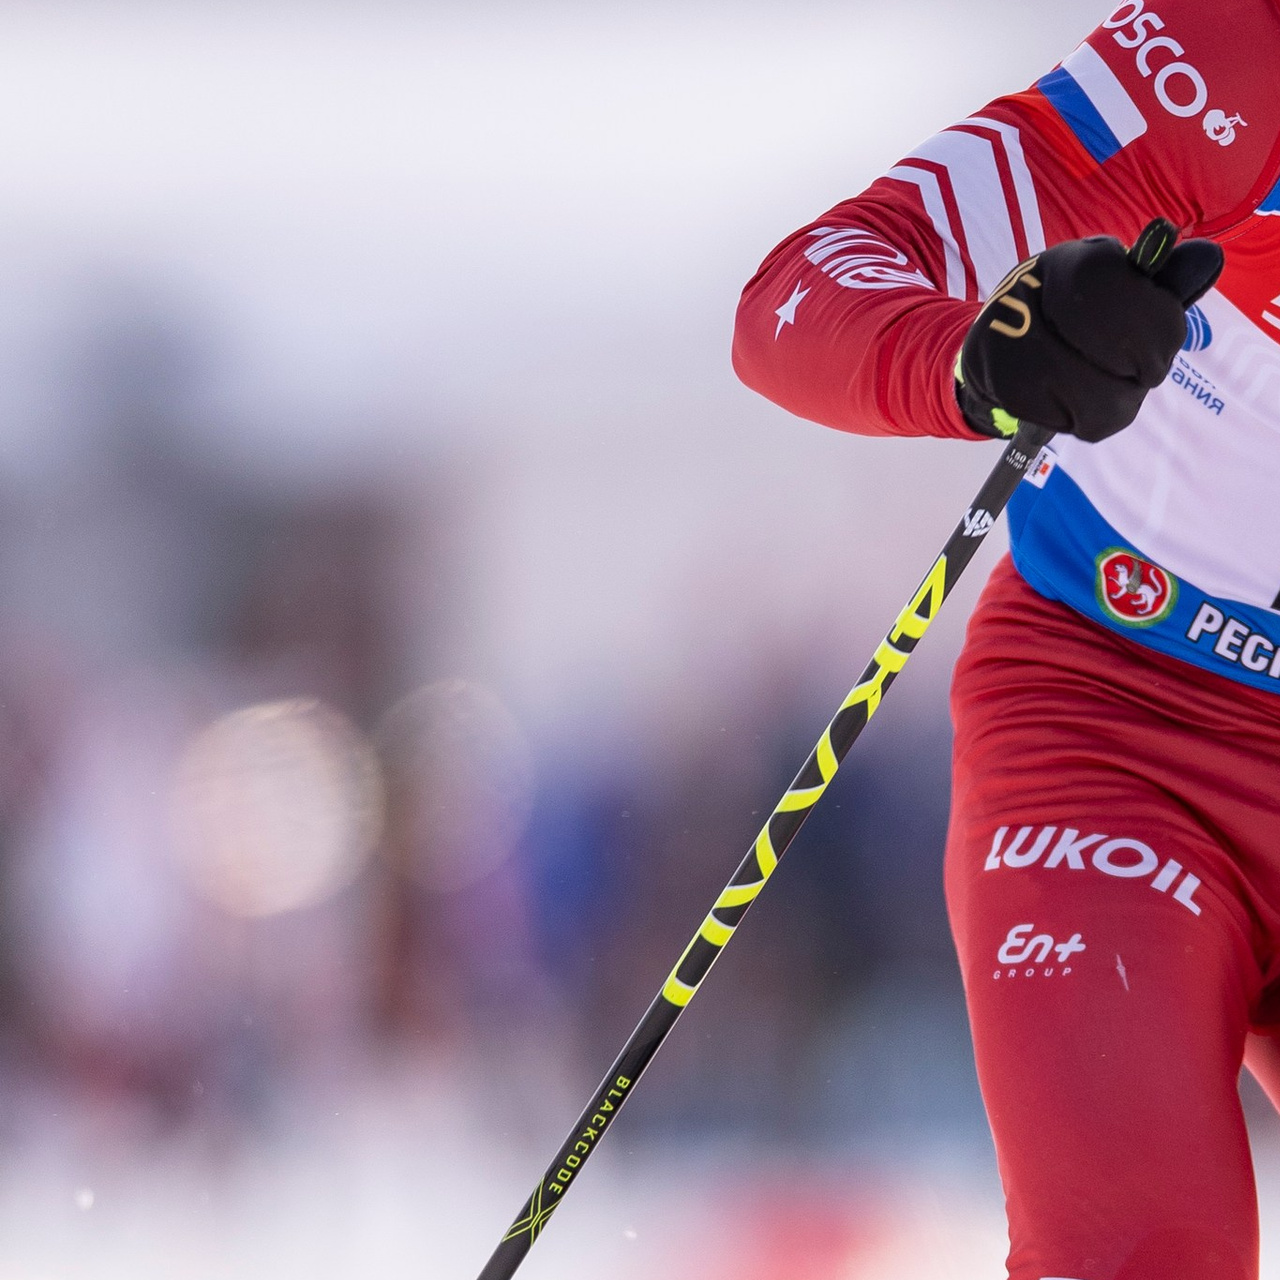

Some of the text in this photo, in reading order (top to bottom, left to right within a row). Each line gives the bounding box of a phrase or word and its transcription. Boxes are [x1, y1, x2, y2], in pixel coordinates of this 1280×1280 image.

[984, 825, 1201, 916] LUKOIL
[993, 966, 1072, 980] GROUP
[997, 923, 1086, 964] En+
[548, 1075, 631, 1195] BLACKCODE
